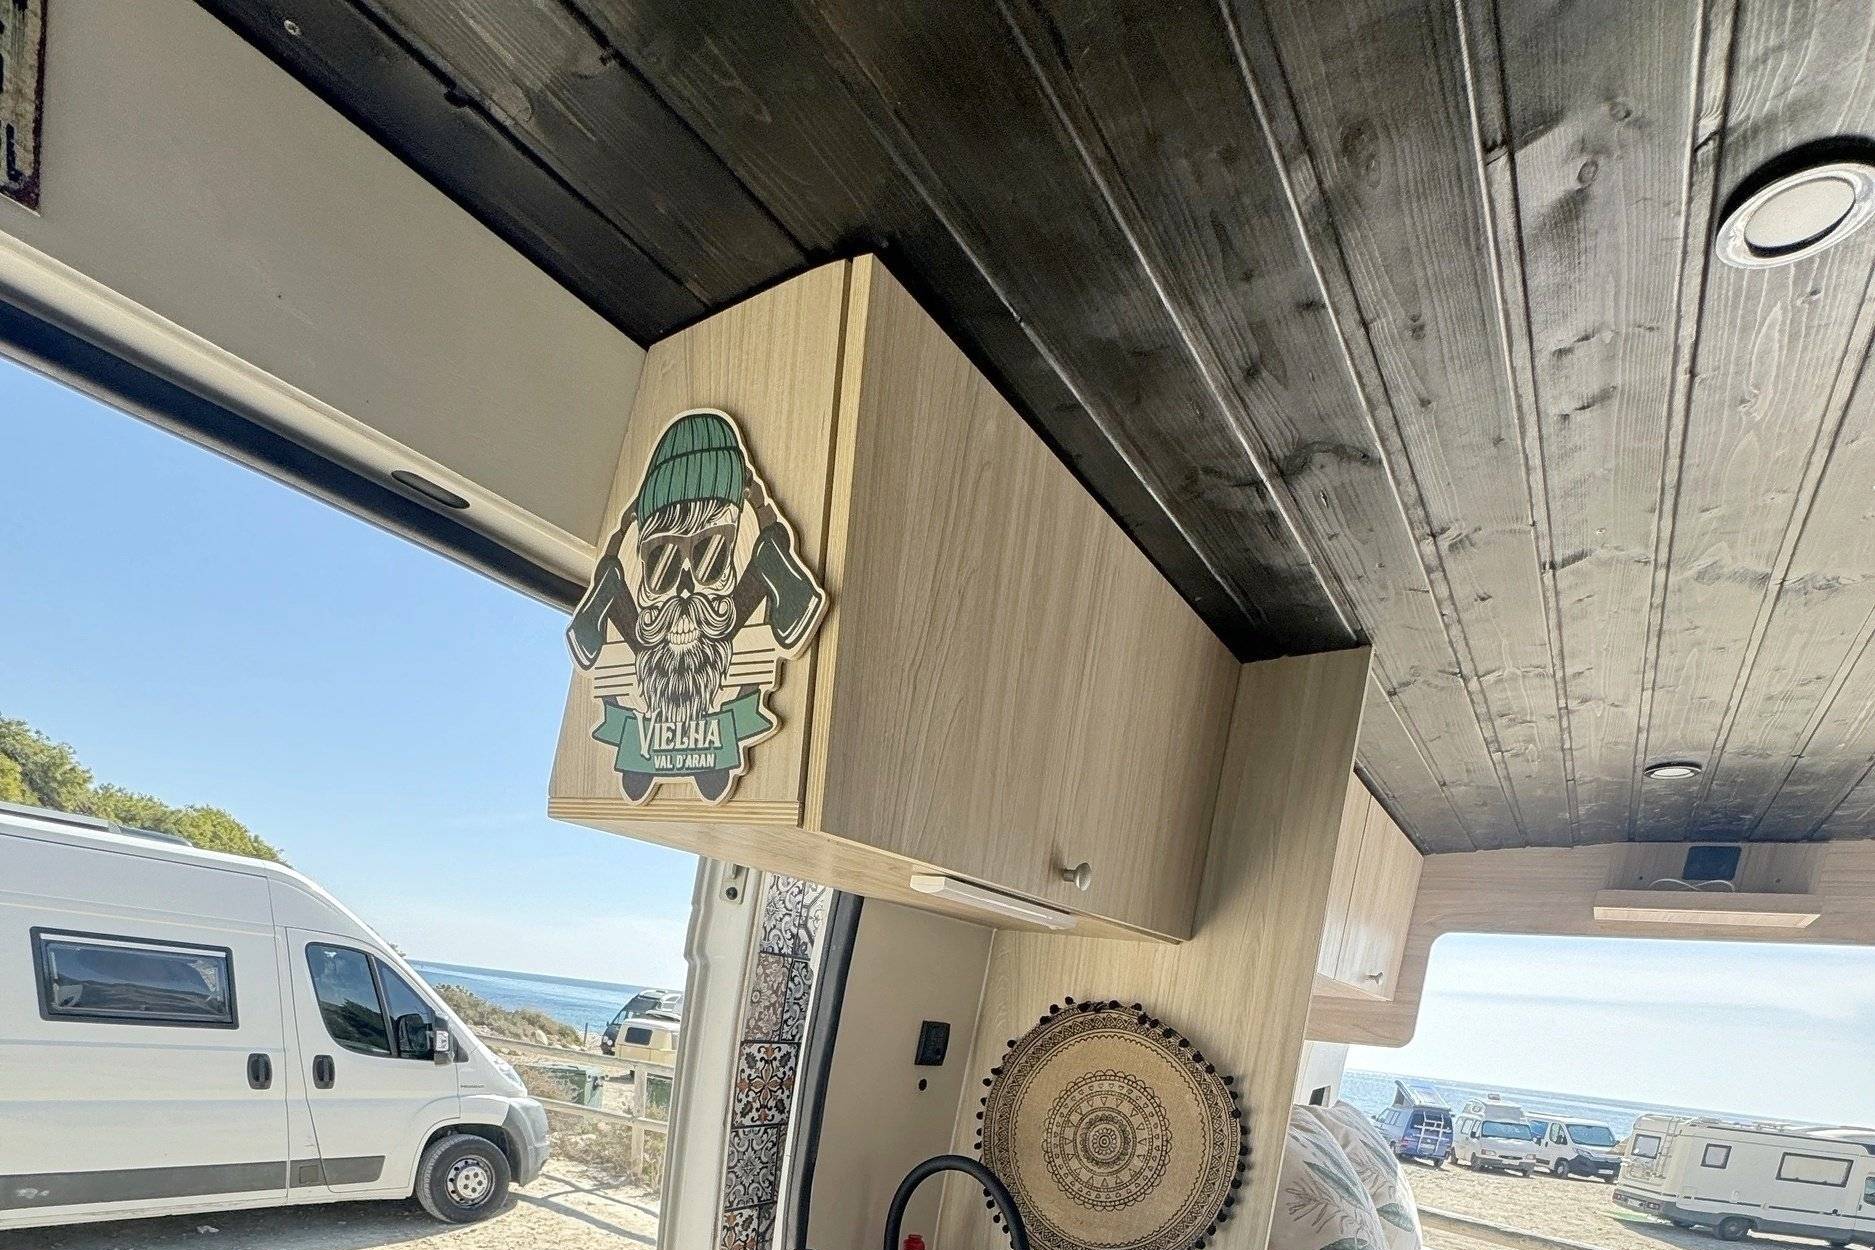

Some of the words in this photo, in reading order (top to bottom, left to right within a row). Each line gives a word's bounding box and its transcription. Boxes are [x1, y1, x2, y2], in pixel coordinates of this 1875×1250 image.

[632, 708, 722, 758] VIELHA
[654, 755, 673, 769] VAL
[676, 753, 715, 769] D'ARAN
